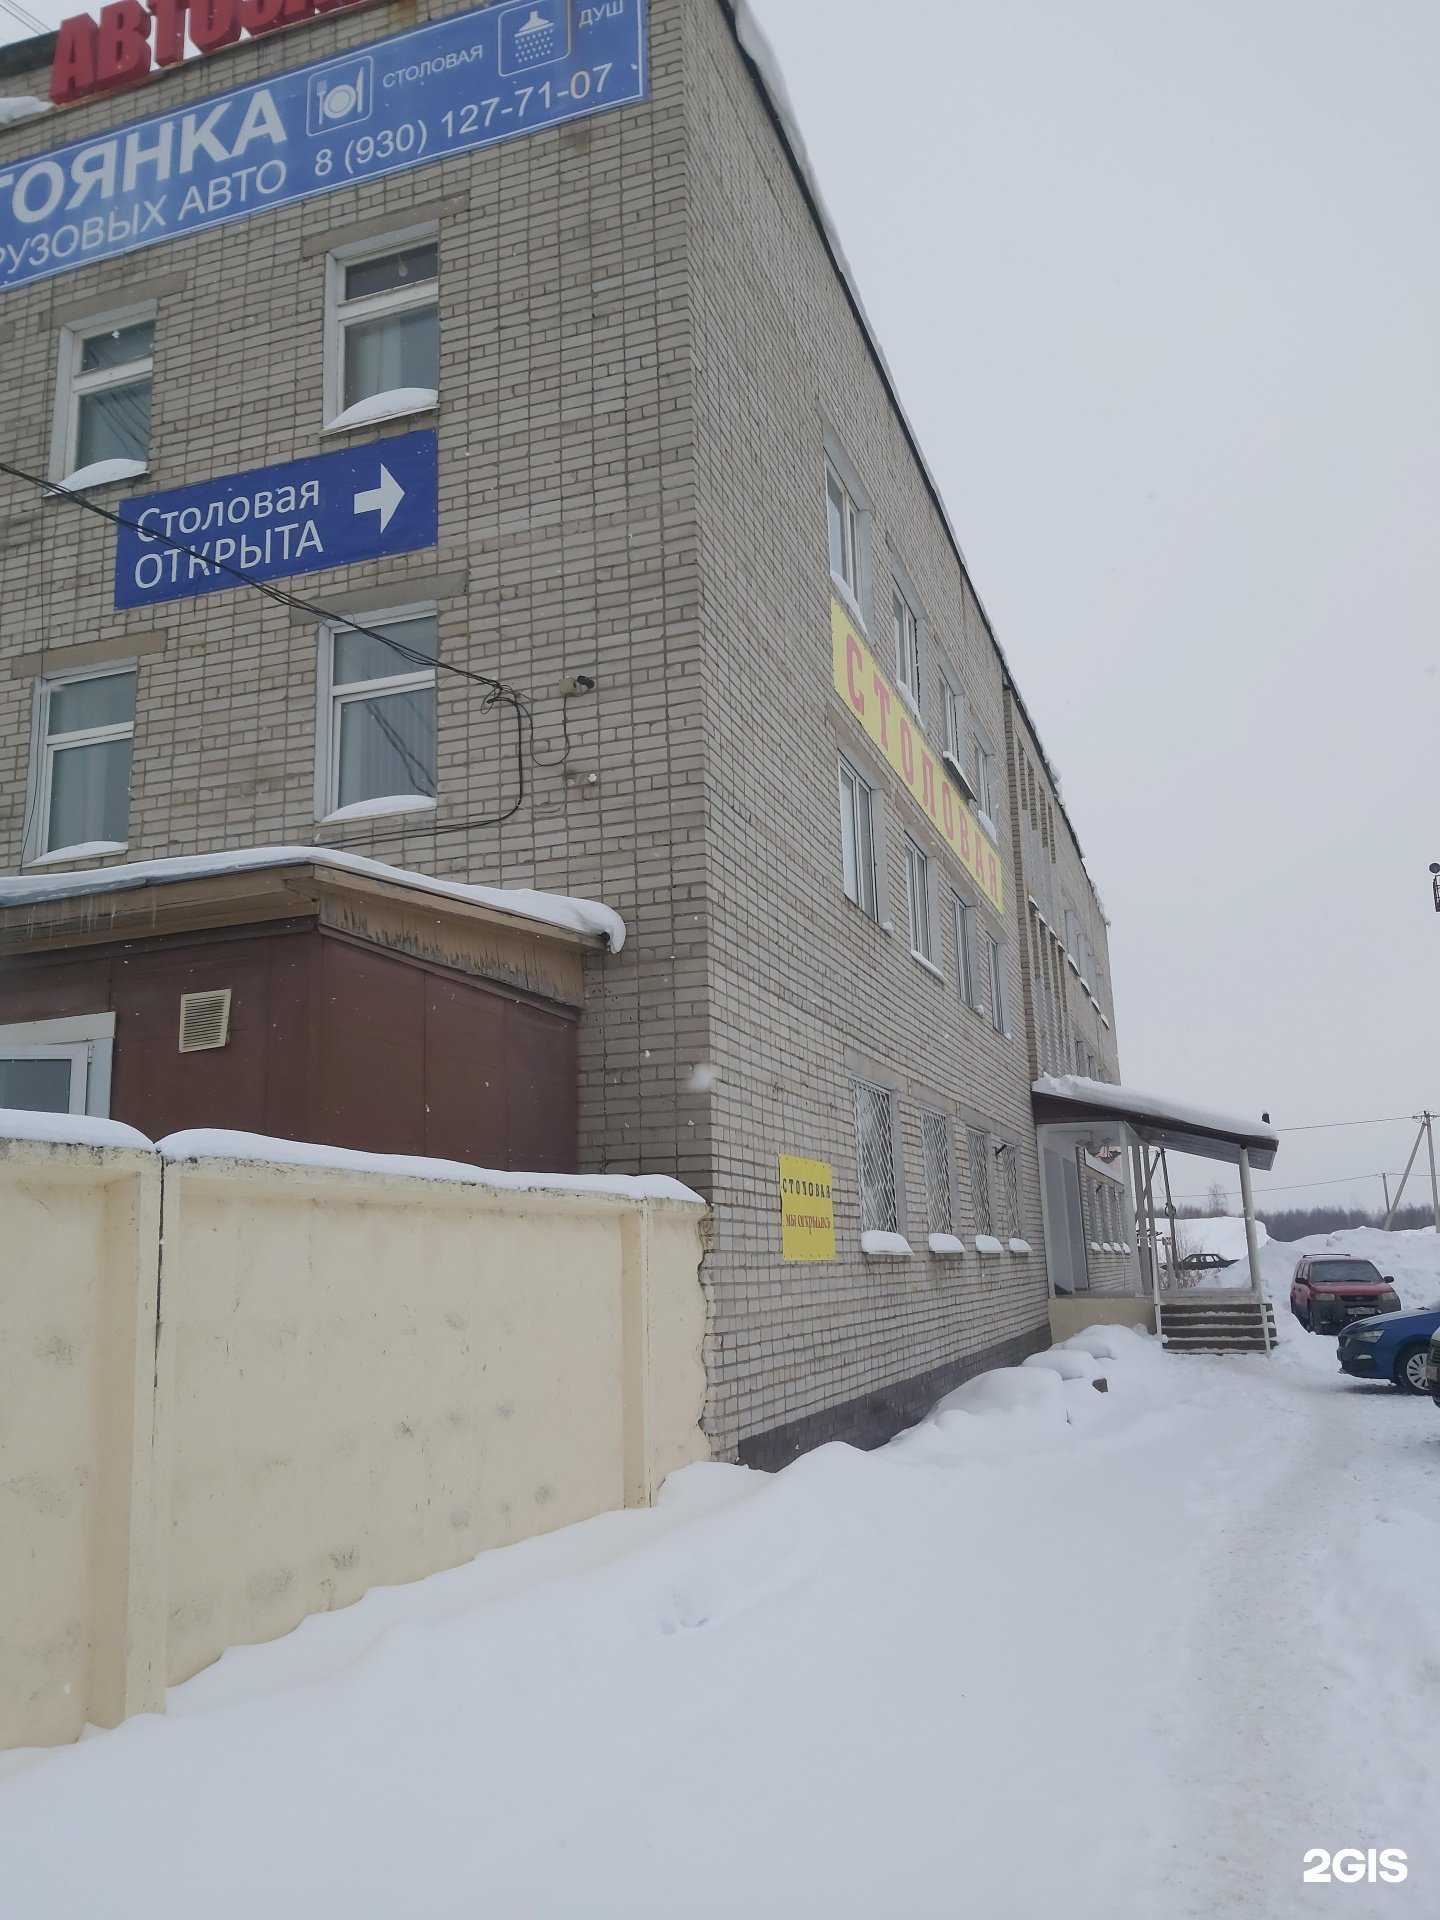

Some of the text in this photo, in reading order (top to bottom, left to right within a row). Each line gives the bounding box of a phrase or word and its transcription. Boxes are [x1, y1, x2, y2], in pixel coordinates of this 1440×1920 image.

[577, 0, 625, 29] ДУШ
[382, 44, 484, 89] СТОЛОВАЯ
[314, 62, 614, 177] 8 (930) 127-71-07
[178, 159, 287, 222] АВТО
[136, 479, 320, 542] Столовая
[133, 519, 325, 590] ОТКРЫТА
[782, 1178, 831, 1198] СТОЛОВАЯ
